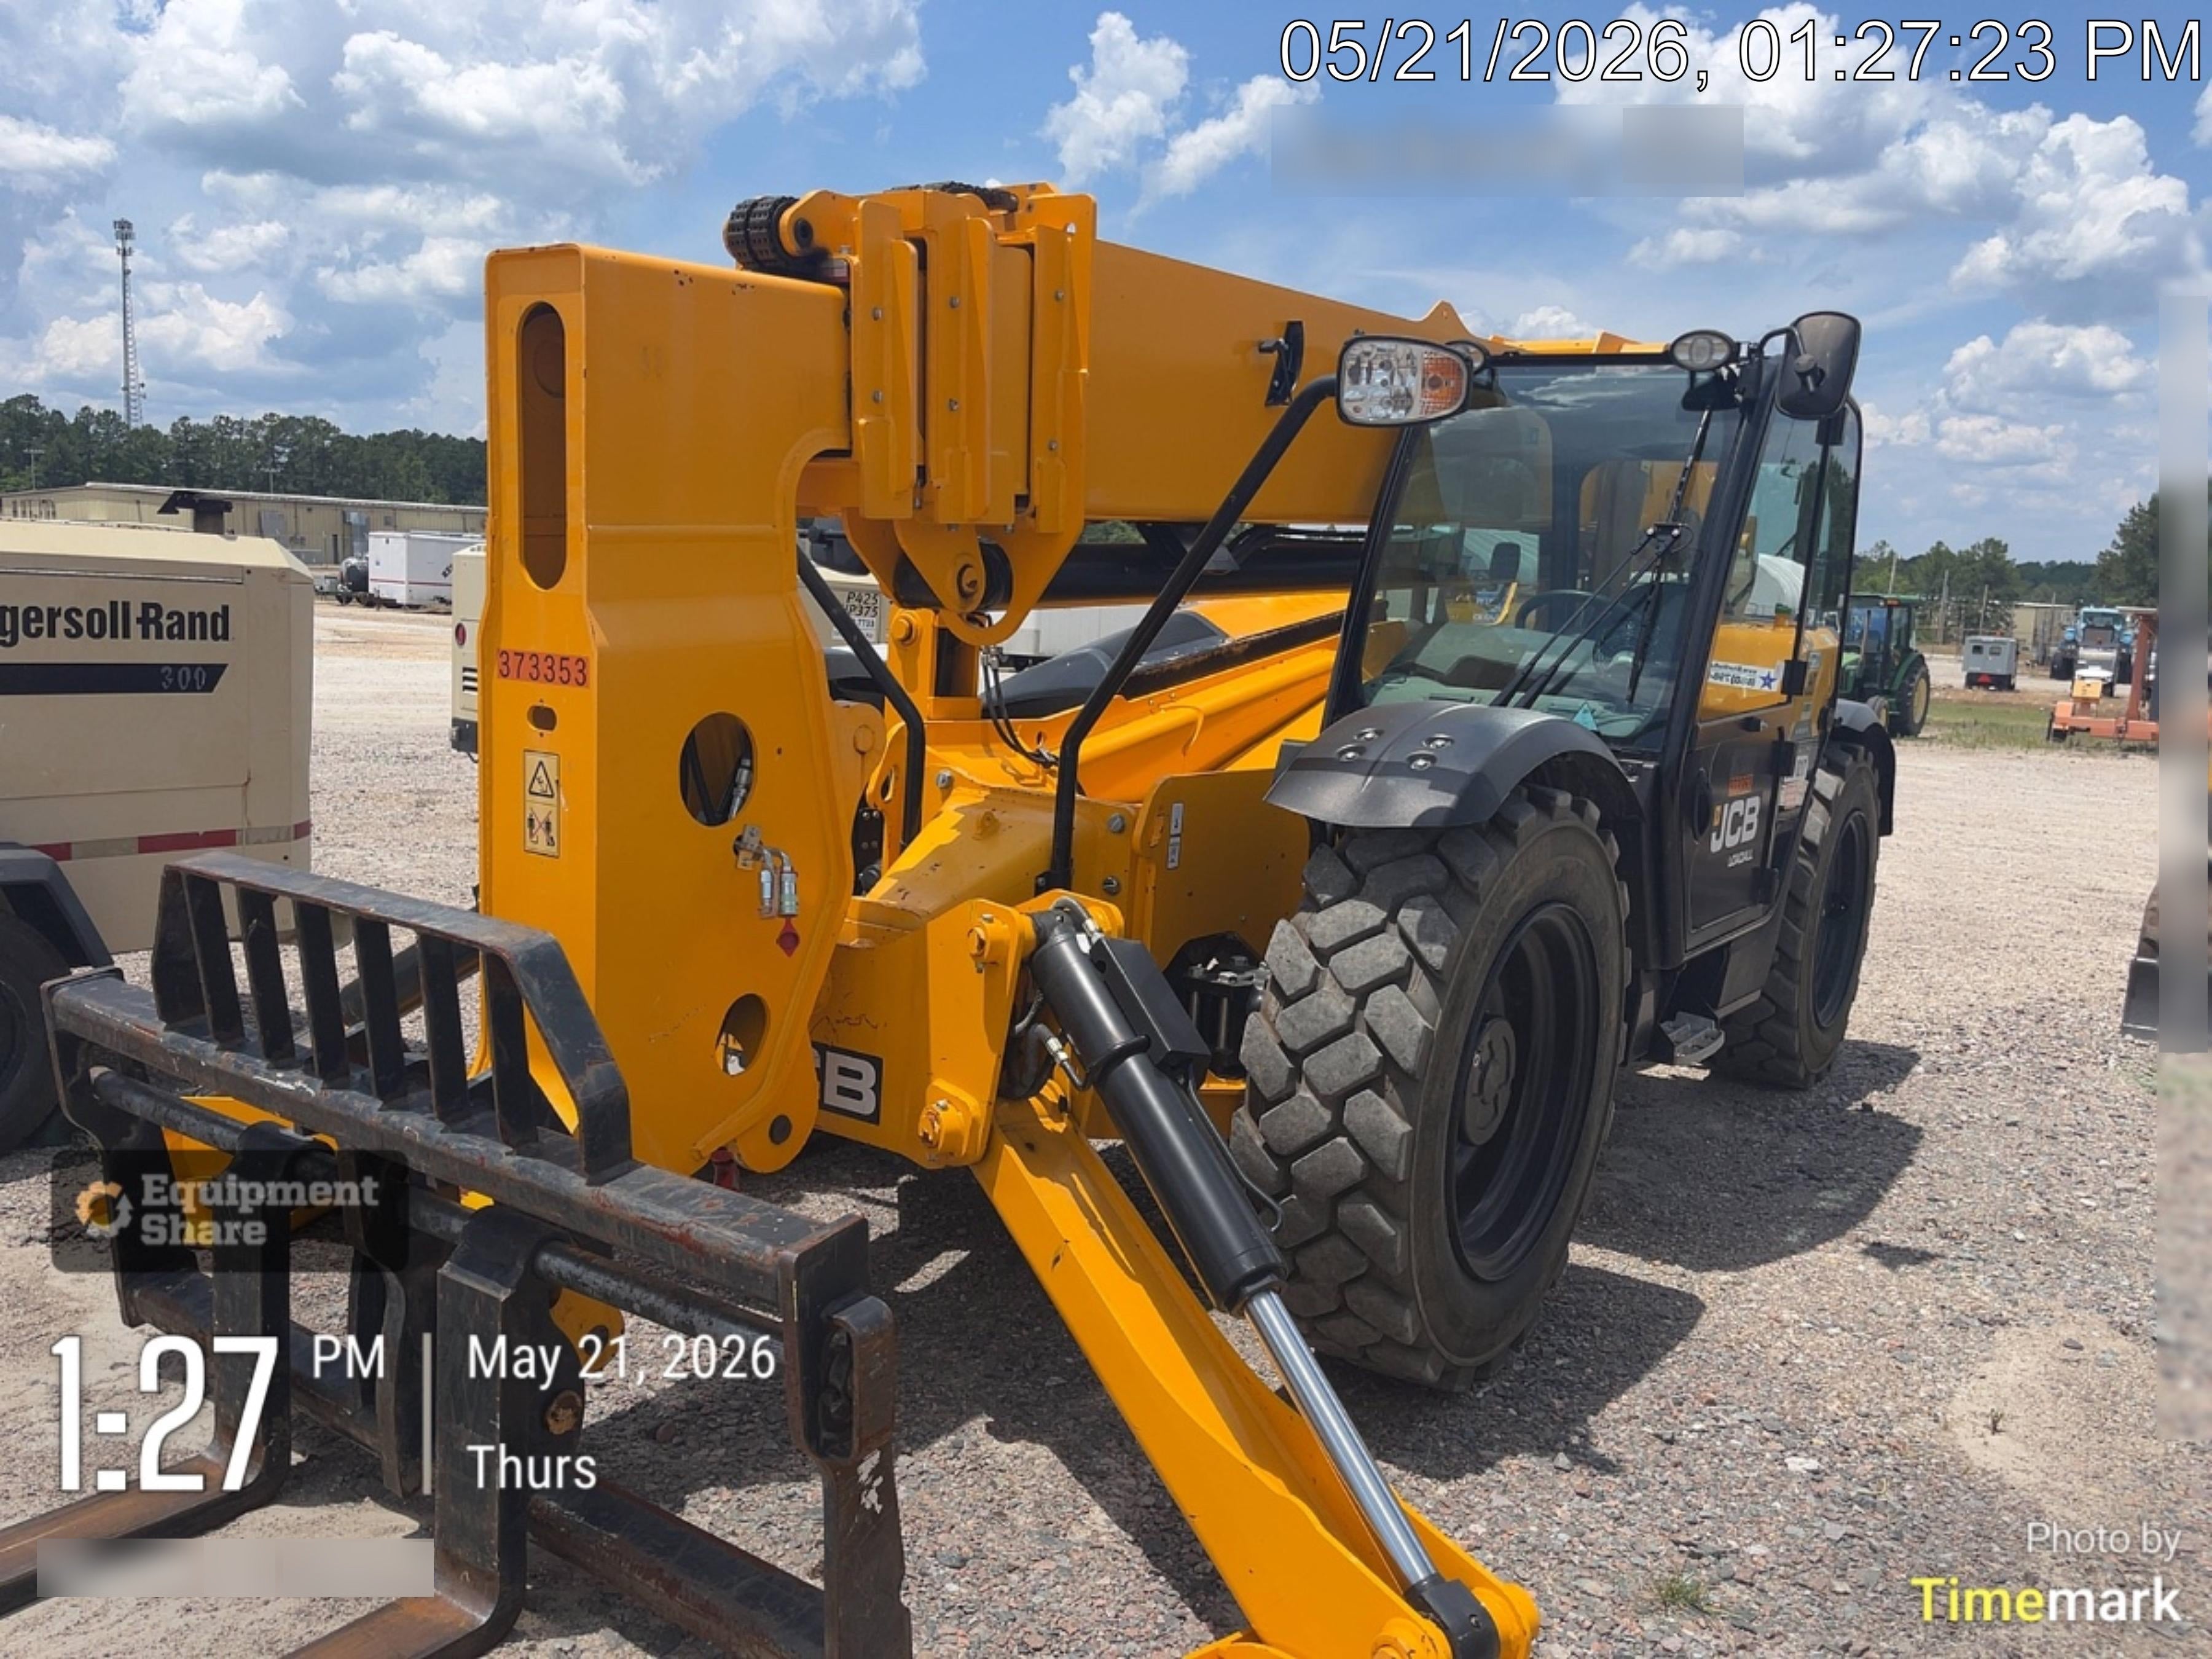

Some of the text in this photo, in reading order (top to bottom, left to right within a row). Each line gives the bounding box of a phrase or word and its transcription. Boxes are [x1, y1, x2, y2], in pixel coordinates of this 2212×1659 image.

[160, 665, 207, 690] 300
[499, 650, 587, 686] 373353
[1710, 796, 1760, 853] JCB
